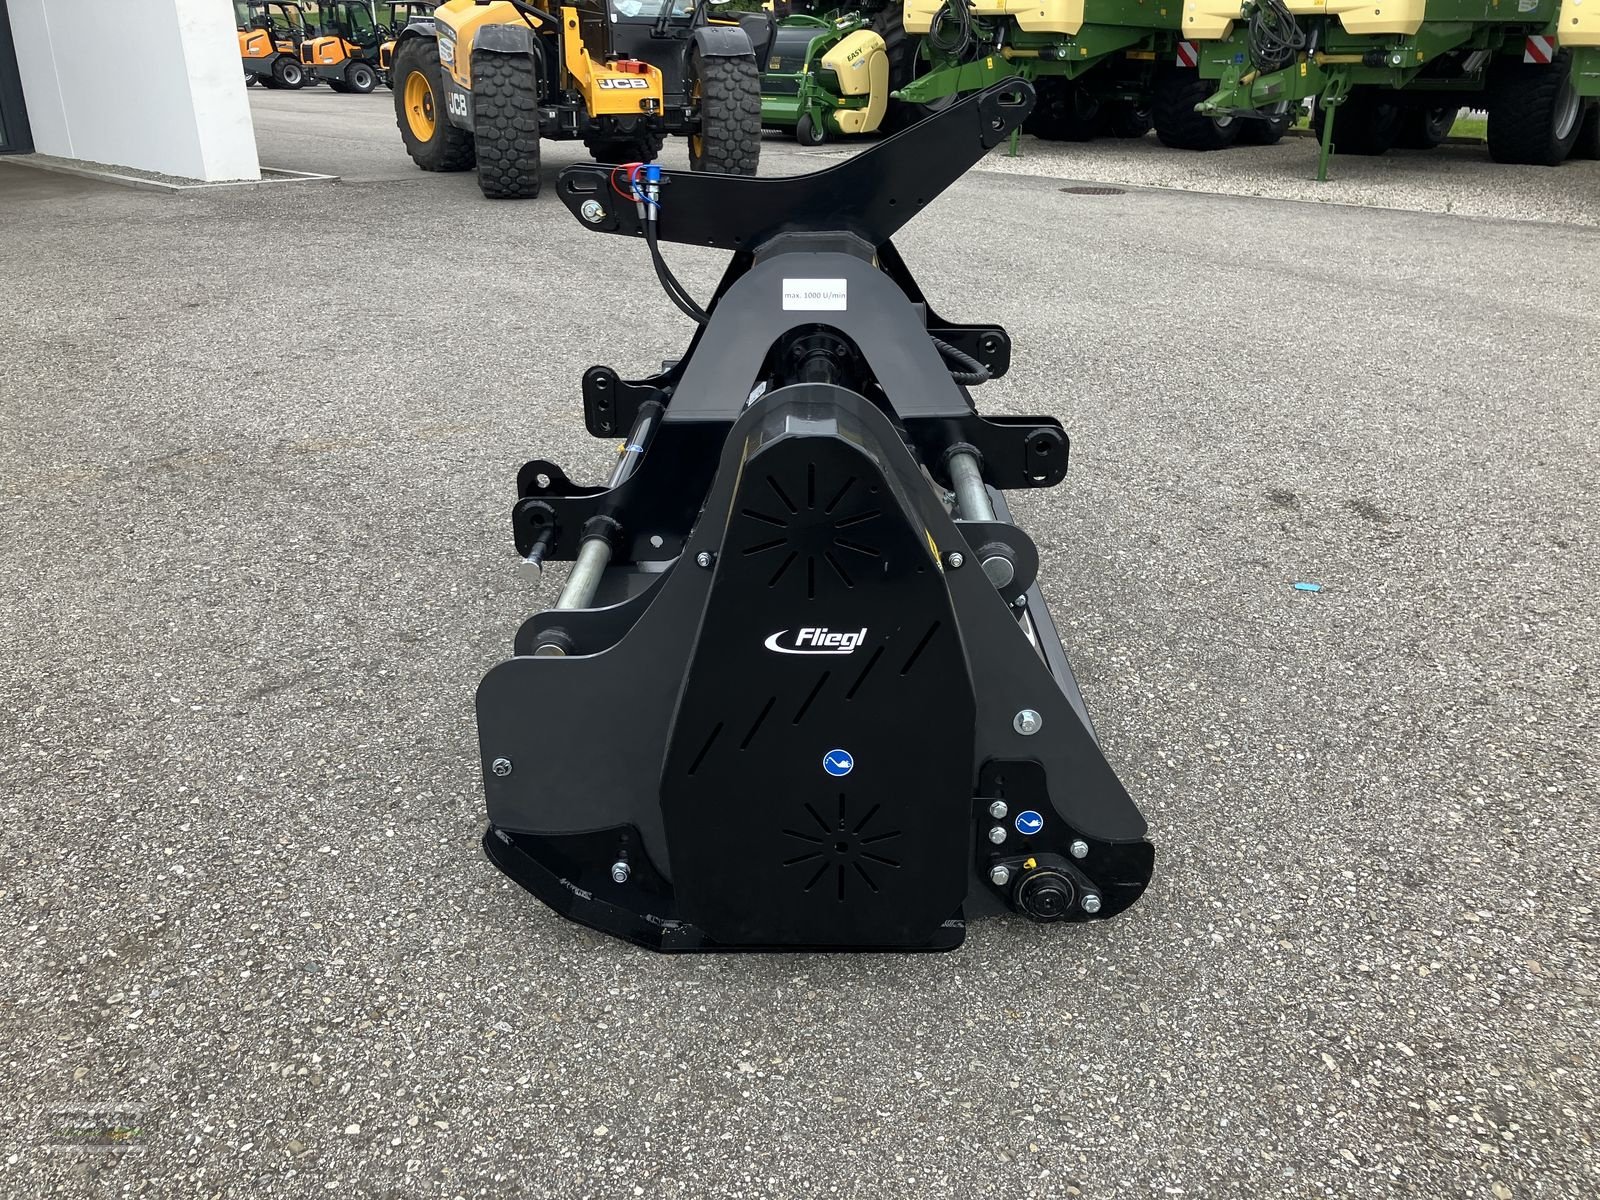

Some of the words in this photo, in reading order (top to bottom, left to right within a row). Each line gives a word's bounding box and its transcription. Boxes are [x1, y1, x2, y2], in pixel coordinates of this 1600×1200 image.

[847, 48, 863, 62] EASY
[597, 79, 649, 89] JCB
[448, 92, 467, 116] JCB
[823, 291, 846, 300] U/min
[795, 627, 868, 650] Fliegl
